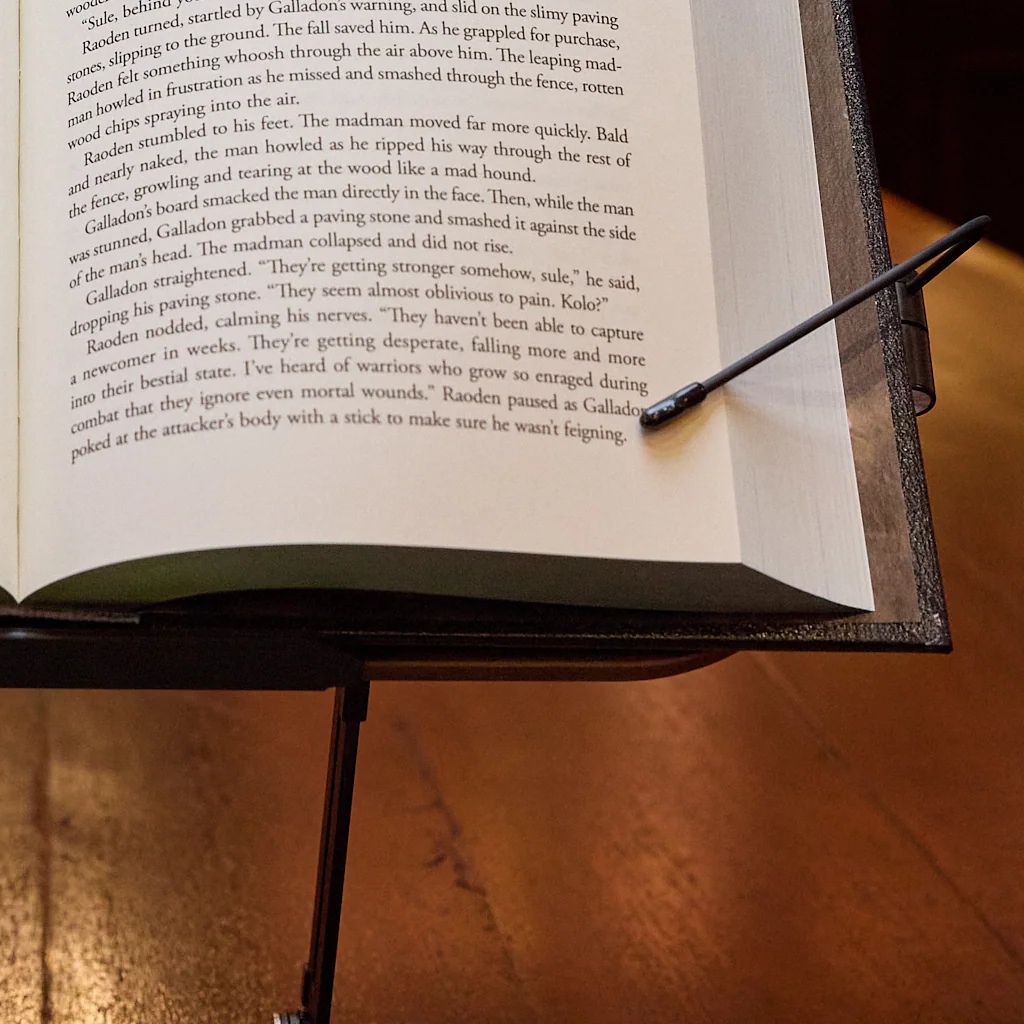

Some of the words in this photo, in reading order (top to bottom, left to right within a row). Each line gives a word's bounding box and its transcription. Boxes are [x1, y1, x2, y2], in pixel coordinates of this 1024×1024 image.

[67, 124, 101, 150] wood
[105, 118, 140, 136] chips
[144, 104, 206, 128] spraying
[211, 99, 241, 112] into
[247, 93, 271, 108] the
[276, 92, 300, 106] air.
[156, 194, 199, 216] board
[203, 186, 270, 208] smacked
[274, 185, 299, 201] the
[303, 189, 338, 199] man
[342, 183, 400, 203] directly
[404, 185, 419, 199] in
[424, 185, 448, 201] the
[452, 185, 485, 203] face.
[487, 188, 531, 208] Then,
[534, 193, 574, 210] while
[577, 196, 600, 213] the
[603, 204, 634, 216] man
[69, 270, 83, 289] of
[85, 266, 105, 283] the
[152, 244, 192, 264] head.
[197, 240, 227, 256] The
[233, 235, 303, 252] madman
[309, 232, 382, 252] collapsed
[388, 233, 416, 248] and
[422, 233, 447, 250] did
[453, 241, 478, 251] not
[484, 239, 513, 254] rise.
[70, 310, 129, 337] dropping
[133, 301, 154, 317] his
[159, 293, 210, 317] paving
[215, 291, 261, 303] stone.
[322, 287, 362, 297] seem
[368, 281, 419, 298] almost
[425, 283, 494, 302] oblivious
[499, 293, 514, 304] to
[519, 292, 555, 310] pain.
[71, 432, 111, 465] poked
[116, 433, 128, 446] at
[134, 425, 157, 442] the
[239, 409, 281, 427] body
[287, 408, 324, 424] with
[330, 414, 338, 424] a
[344, 408, 381, 424] stick
[387, 414, 403, 425] to
[409, 410, 451, 427] make
[456, 418, 487, 430] sure
[492, 414, 510, 432] he
[564, 420, 627, 447] feigning.
